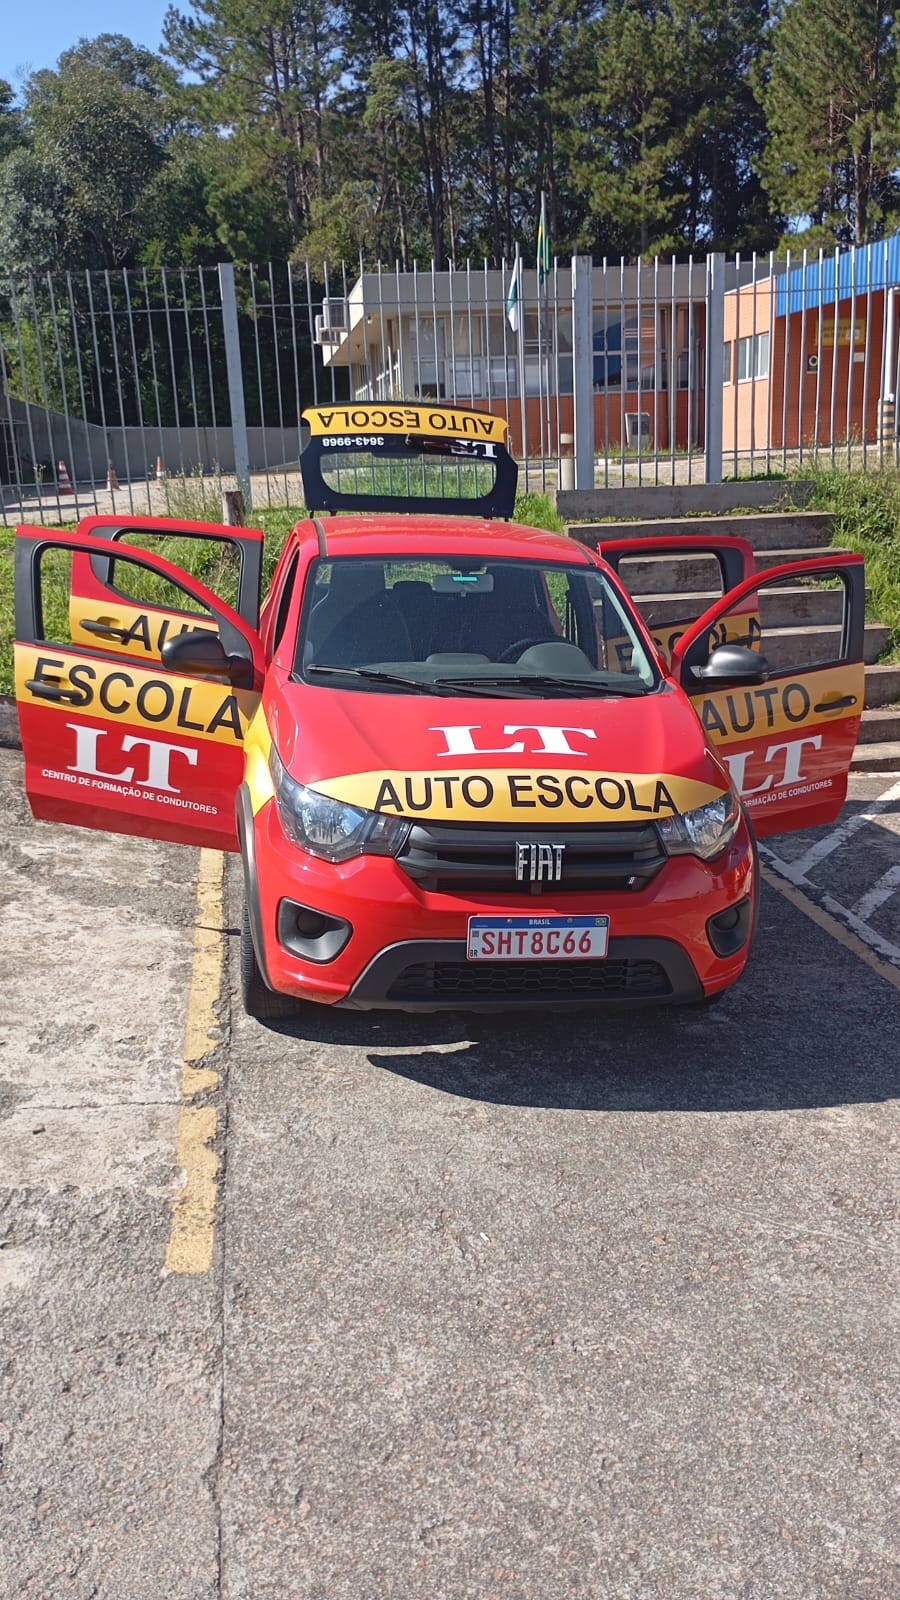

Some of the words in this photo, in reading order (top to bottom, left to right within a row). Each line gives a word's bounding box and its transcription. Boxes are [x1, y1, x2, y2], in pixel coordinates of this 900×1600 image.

[317, 410, 420, 429] ESCOLA
[428, 413, 494, 435] AUTO
[322, 436, 384, 447] 3643-9968
[31, 657, 244, 740] ESCOLA
[702, 683, 810, 737] AUTO
[66, 723, 198, 794] LT
[428, 725, 598, 757] LT
[722, 734, 823, 796] LT
[42, 769, 77, 784] CENTRO
[78, 777, 90, 787] DE
[92, 780, 141, 798] FORMAÇÃO
[143, 791, 155, 801] DE
[156, 794, 218, 815] CONDUTORES
[374, 776, 494, 812] AUTO
[507, 775, 678, 814] ESCOLA
[743, 792, 777, 807] ORMAÇÃO
[778, 790, 788, 800] DE
[788, 779, 833, 797] CONDUTORES
[515, 841, 566, 880] FIAT
[481, 930, 592, 955] SHT8C66
